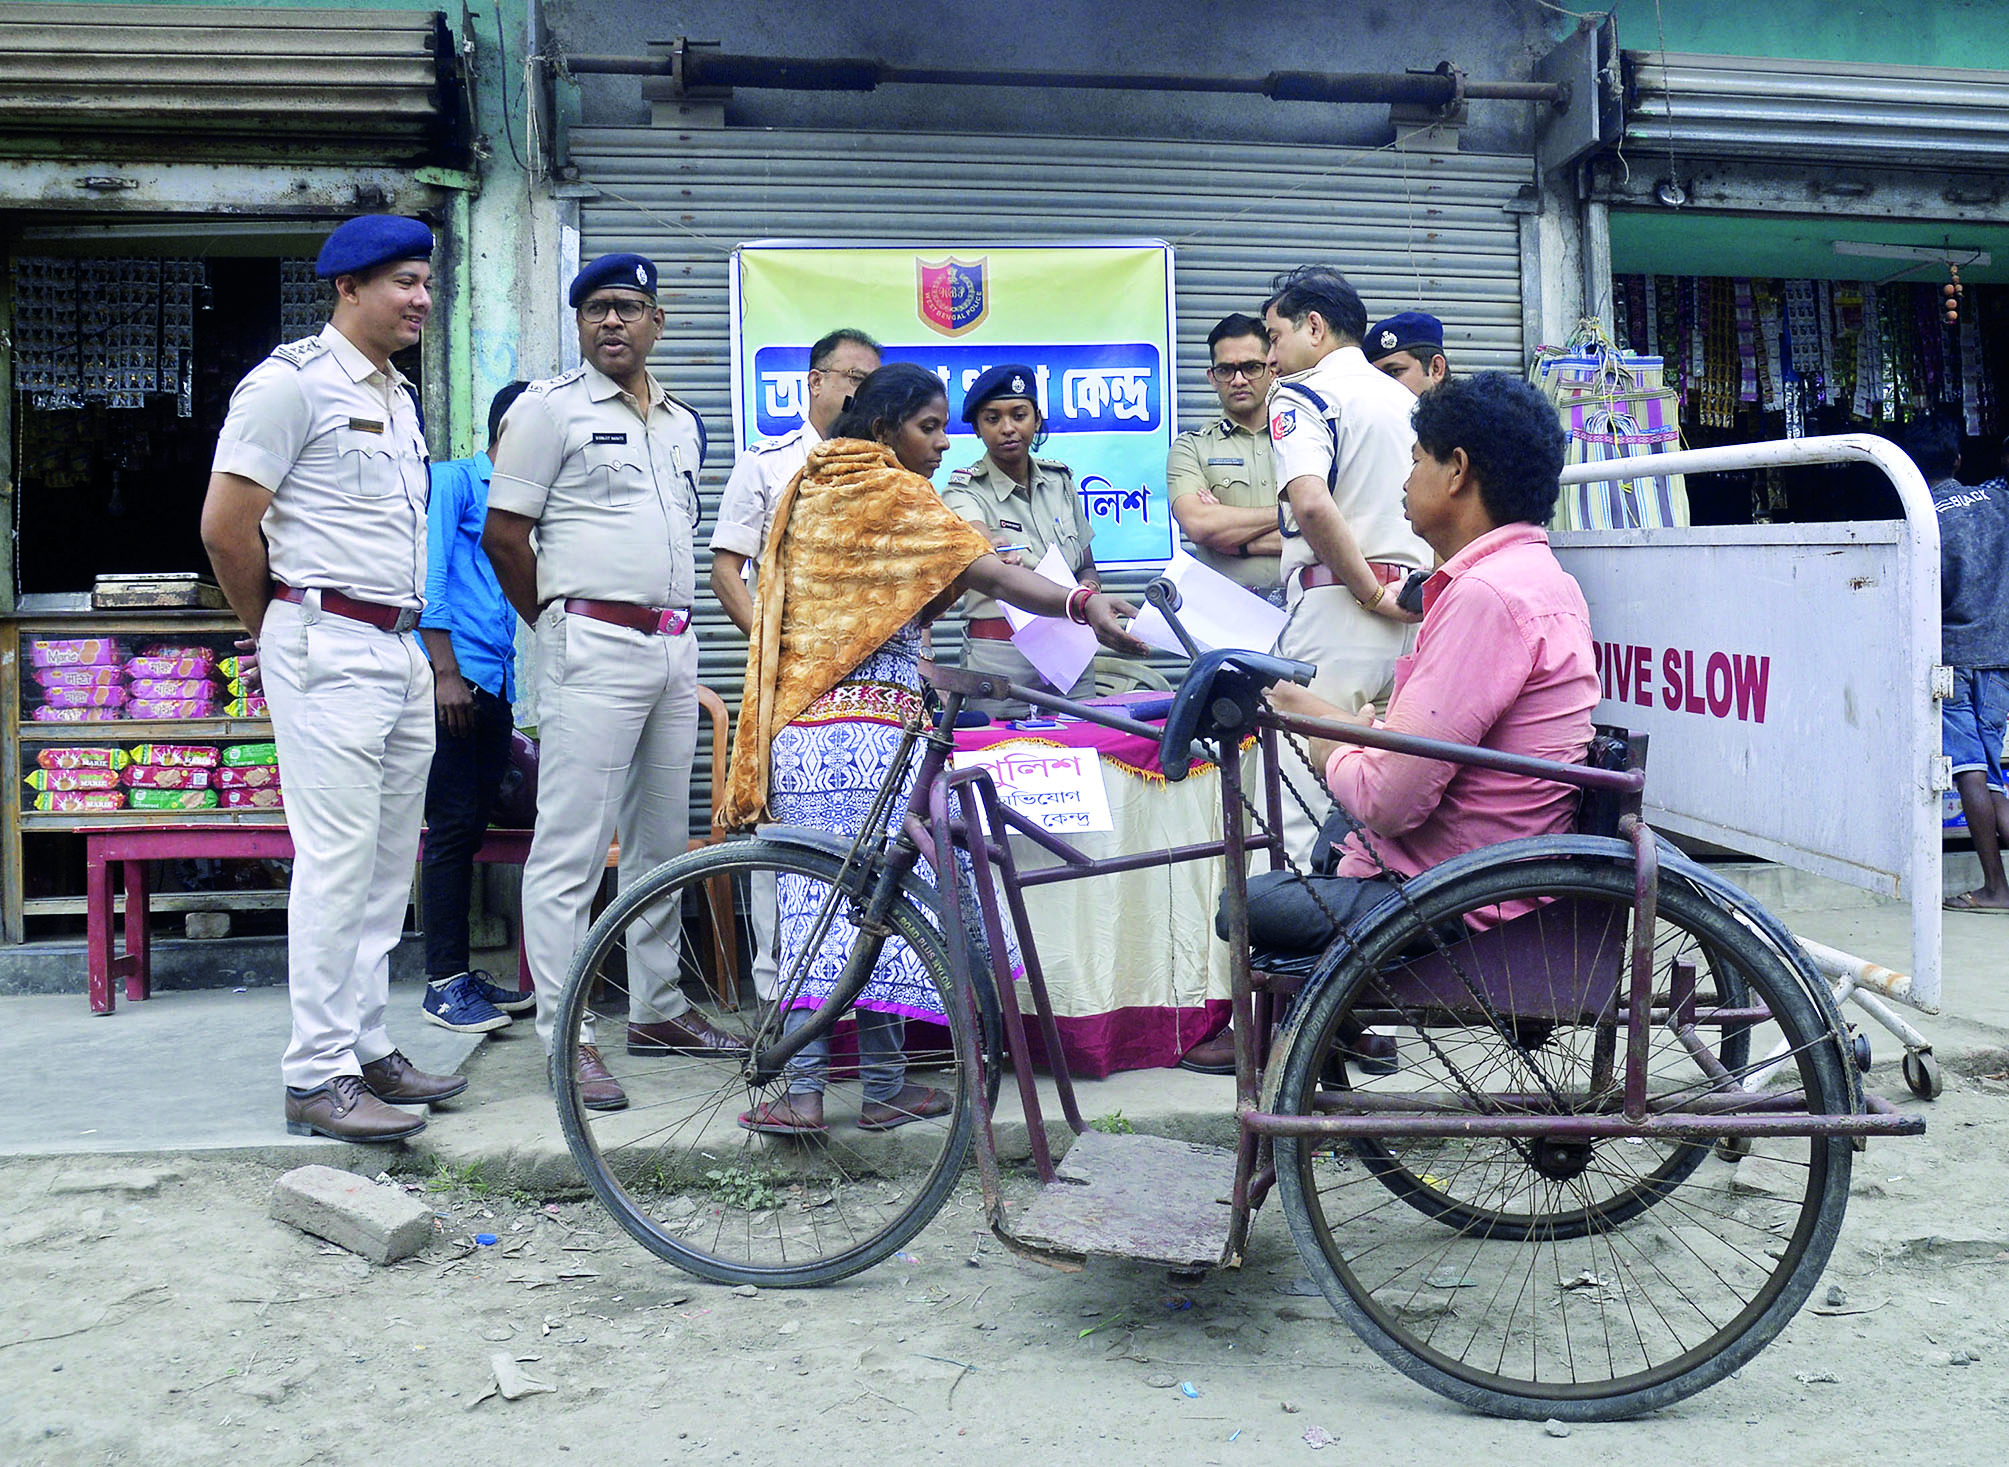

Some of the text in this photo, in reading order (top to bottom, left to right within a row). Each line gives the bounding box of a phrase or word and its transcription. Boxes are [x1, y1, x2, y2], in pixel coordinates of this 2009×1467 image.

[924, 291, 982, 321] WEST BENGAL POLICE
[1062, 367, 1151, 422] কেন্দ্র
[1948, 489, 1991, 508] BLACK
[47, 649, 79, 664] Marie
[1662, 647, 1770, 724] SLOW
